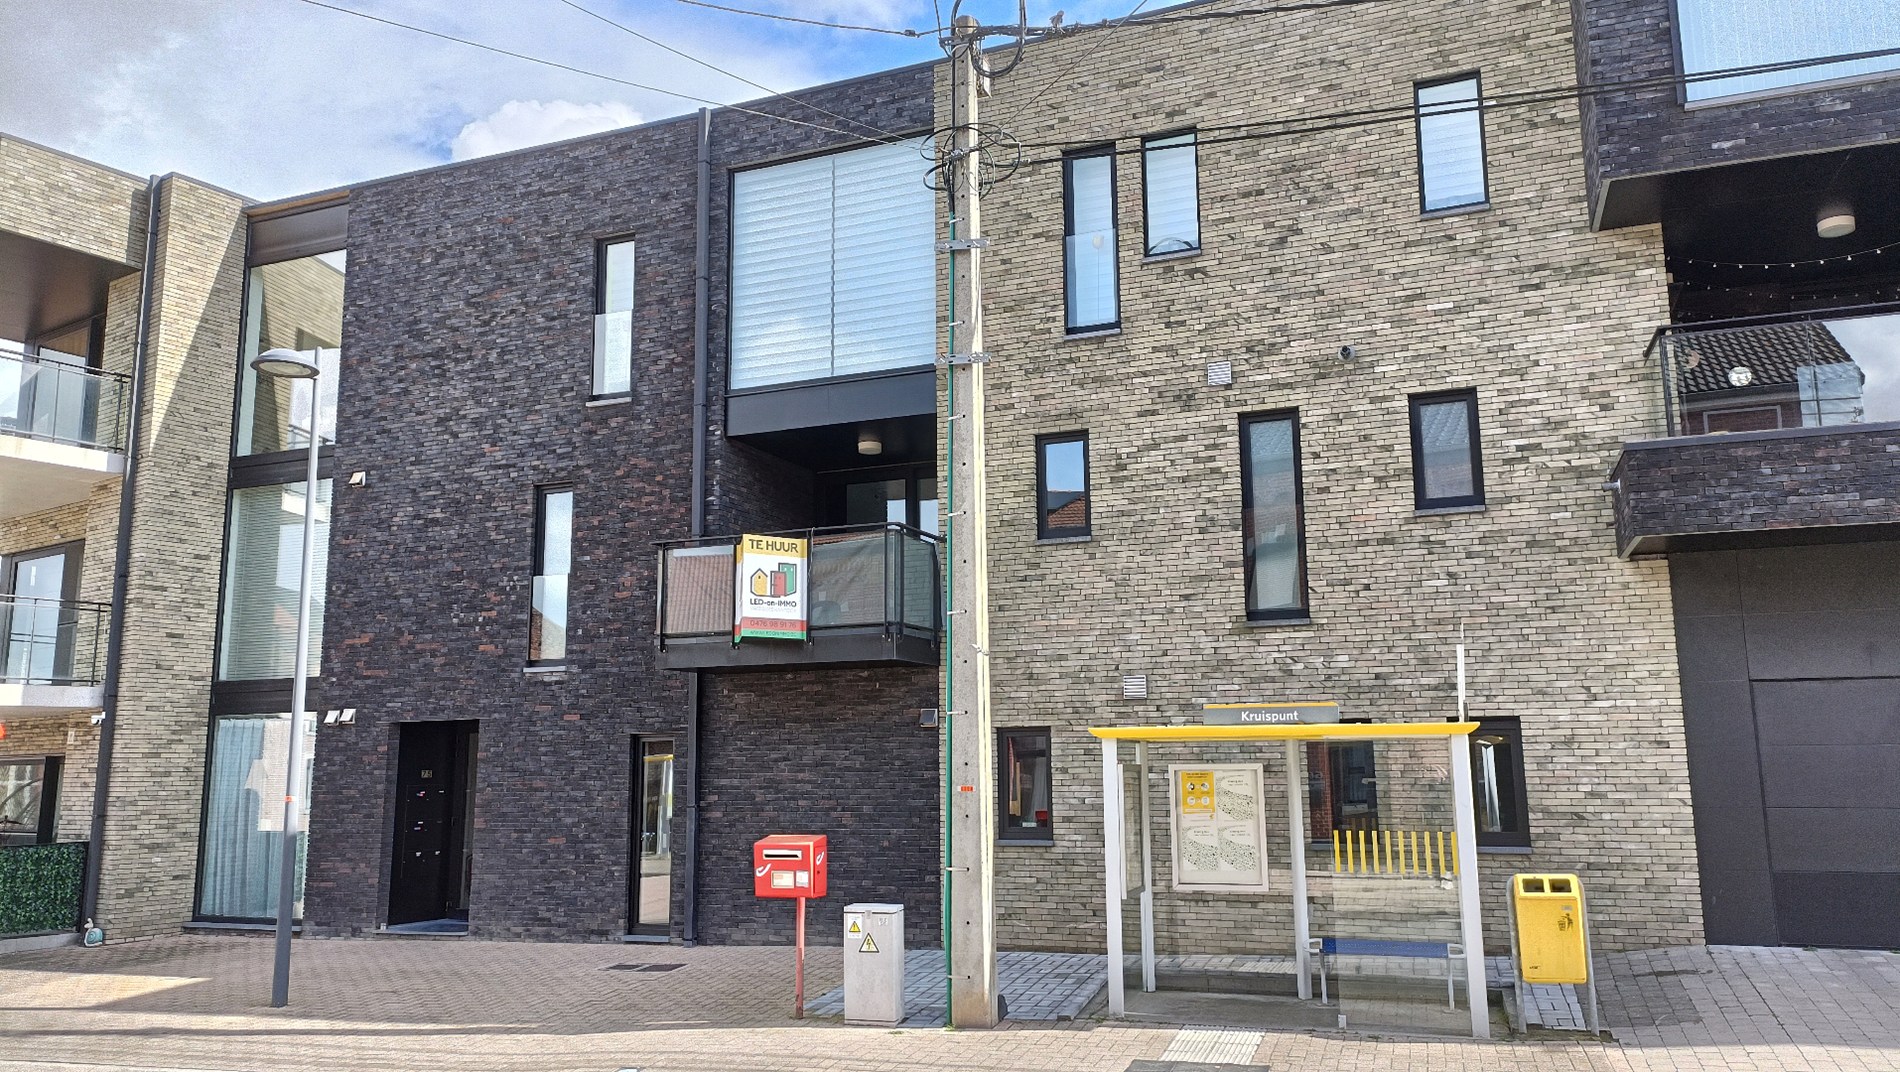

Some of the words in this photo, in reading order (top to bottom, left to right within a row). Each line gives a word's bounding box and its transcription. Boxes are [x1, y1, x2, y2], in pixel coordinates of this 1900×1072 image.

[748, 539, 763, 550] TE
[766, 540, 798, 553] HUUR
[1241, 710, 1299, 723] Kruispunt
[422, 770, 432, 778] 75
